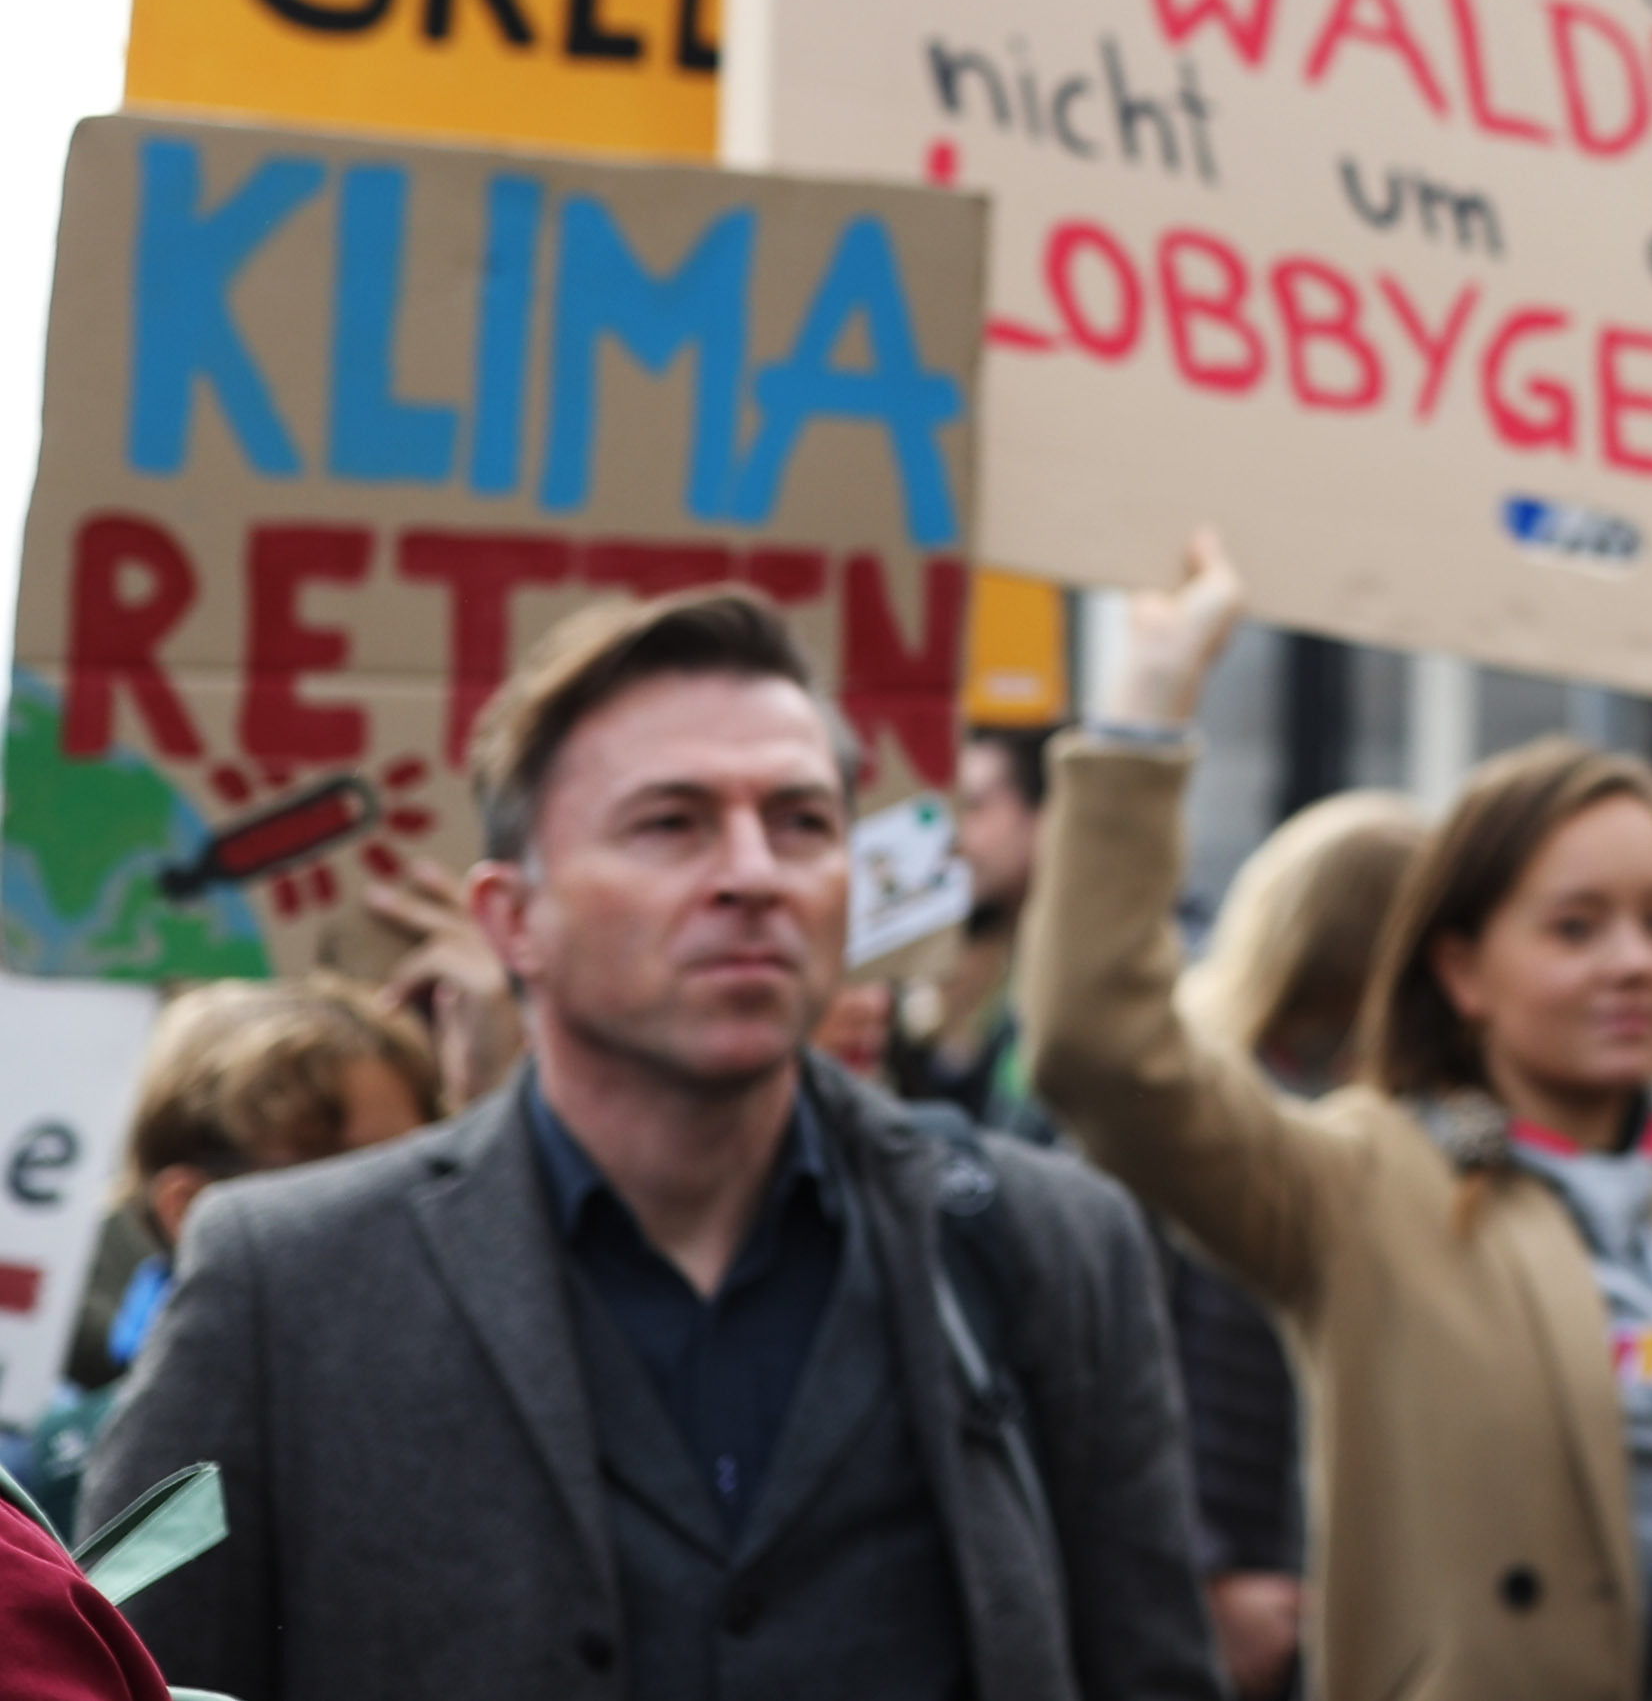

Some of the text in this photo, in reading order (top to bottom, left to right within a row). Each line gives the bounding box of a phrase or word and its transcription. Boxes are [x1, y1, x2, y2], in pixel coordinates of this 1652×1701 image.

[925, 31, 1222, 189] nicht
[1337, 154, 1508, 262] um
[126, 137, 964, 551] KLIMA
[60, 507, 968, 793] RETN
